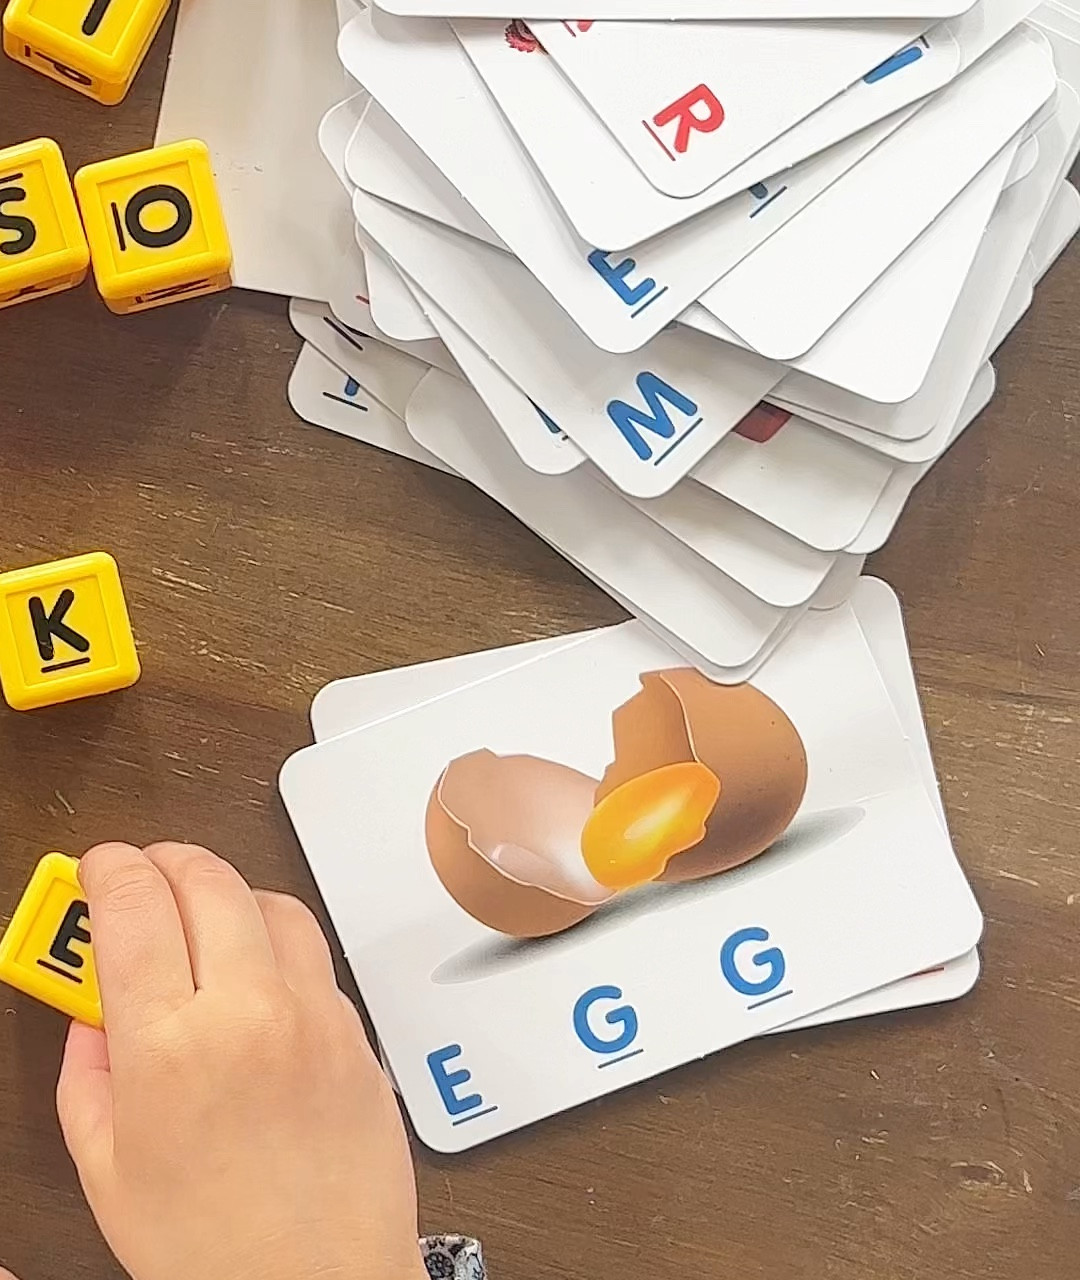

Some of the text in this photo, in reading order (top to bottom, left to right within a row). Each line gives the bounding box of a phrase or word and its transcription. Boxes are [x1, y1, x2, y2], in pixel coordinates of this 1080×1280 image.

[653, 84, 726, 154] R
[607, 371, 698, 462] M
[28, 589, 90, 661] K
